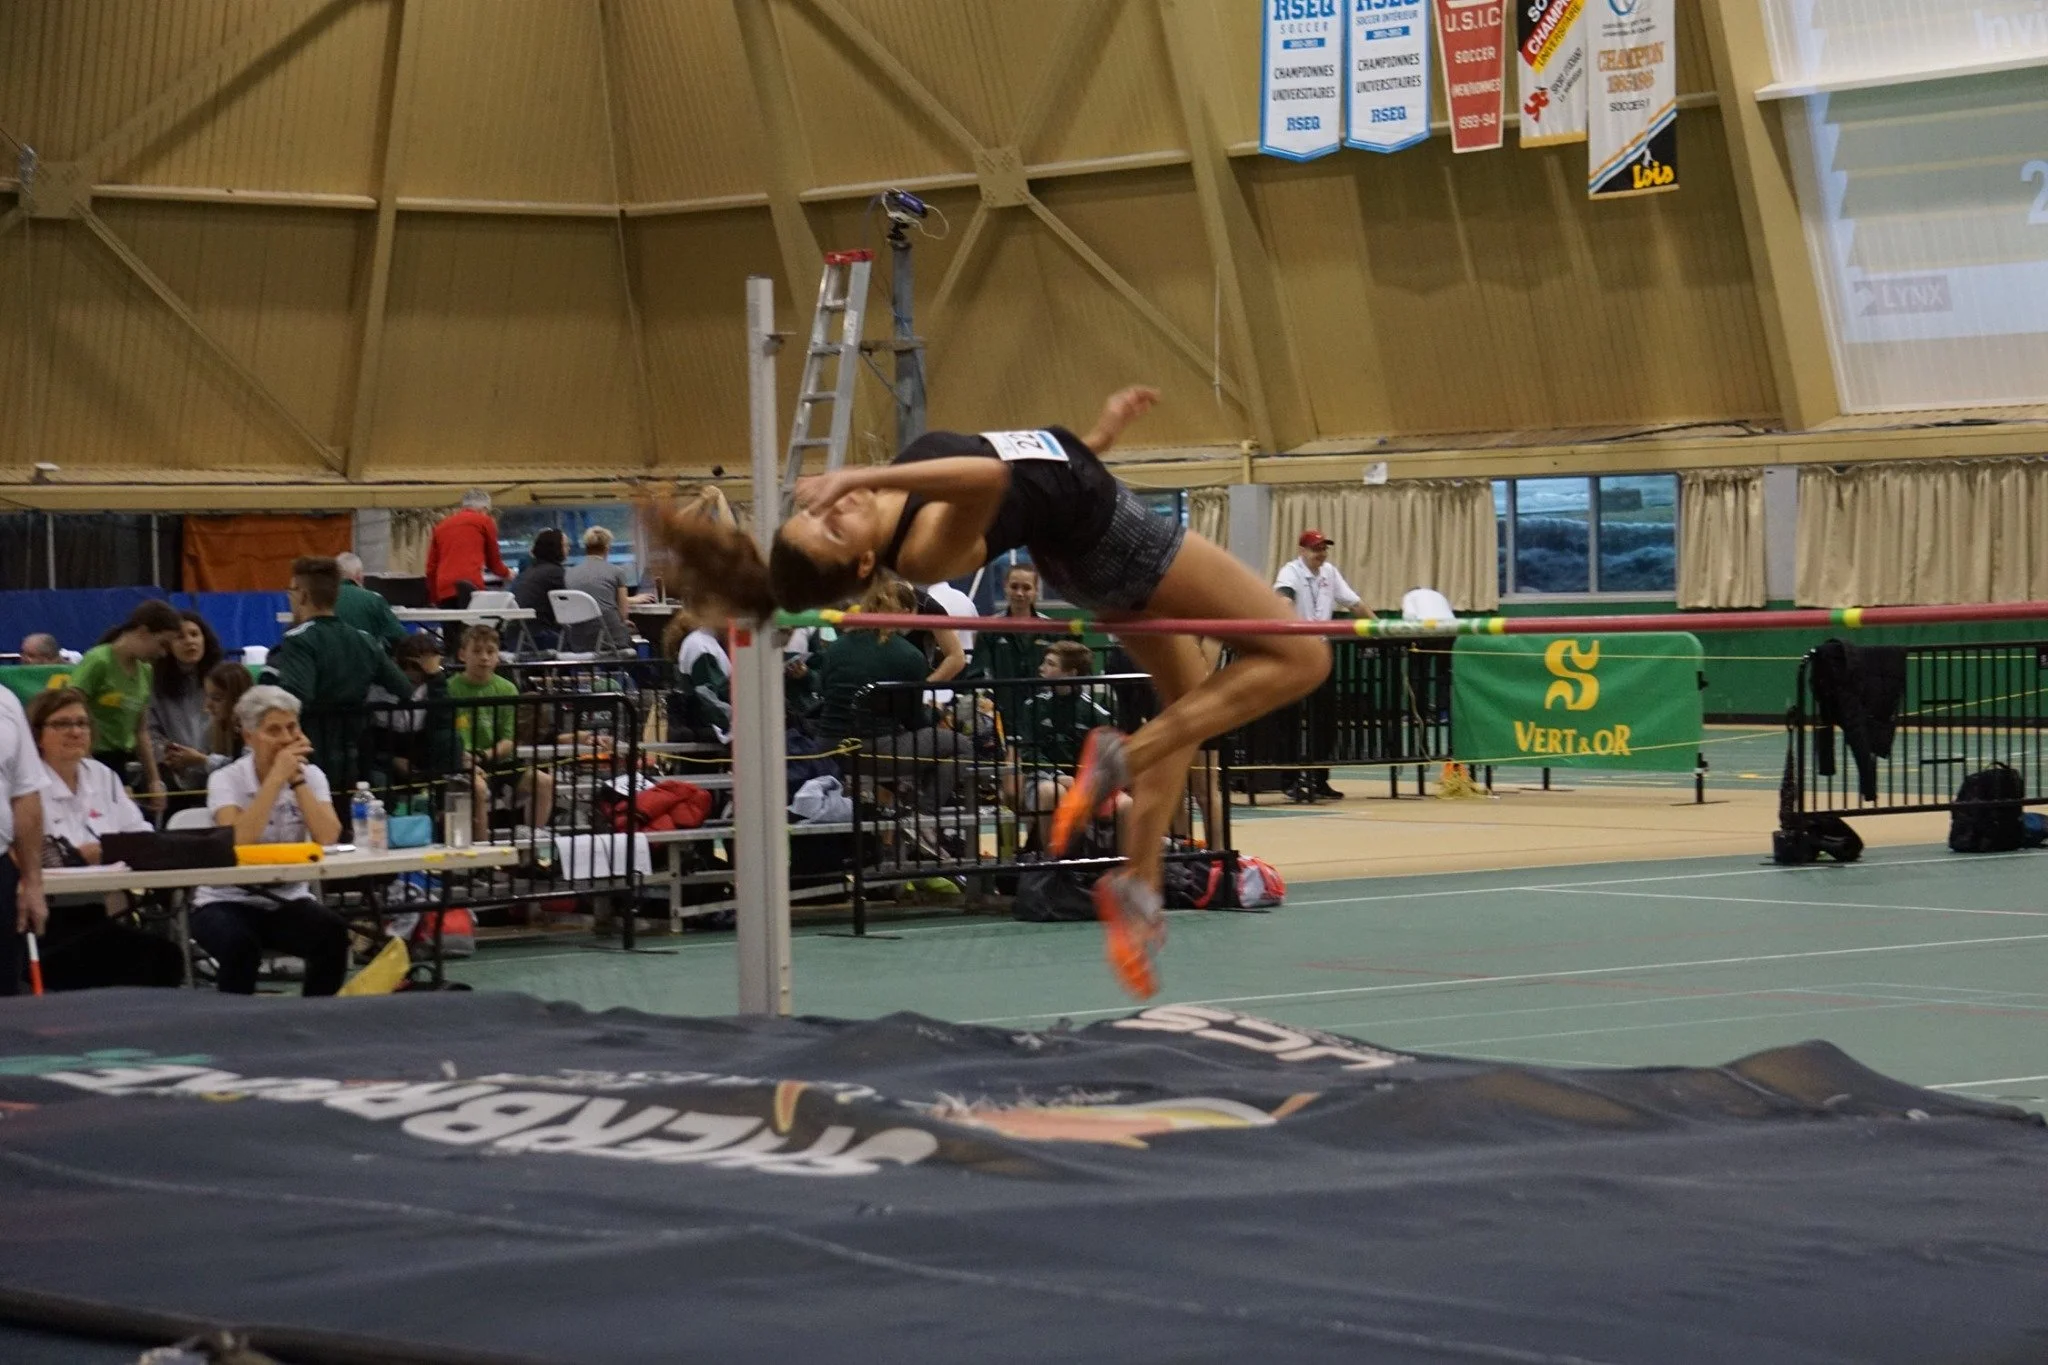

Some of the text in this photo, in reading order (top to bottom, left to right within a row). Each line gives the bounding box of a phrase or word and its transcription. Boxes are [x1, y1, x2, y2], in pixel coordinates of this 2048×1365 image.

[1274, 0, 1337, 20] RSEQ
[1280, 21, 1329, 35] SOCCER
[1357, 53, 1421, 72] CHAMPIONNES
[1454, 46, 1496, 64] SOCCER
[1274, 64, 1335, 80] CHAMPIONNES
[1356, 74, 1422, 94] UNIVERSITAIRES
[1272, 86, 1336, 102] UNIVERSITAIRES
[1286, 115, 1321, 131] RSEQ
[1371, 105, 1407, 123] RSEQ
[1882, 283, 1944, 308] LYNX
